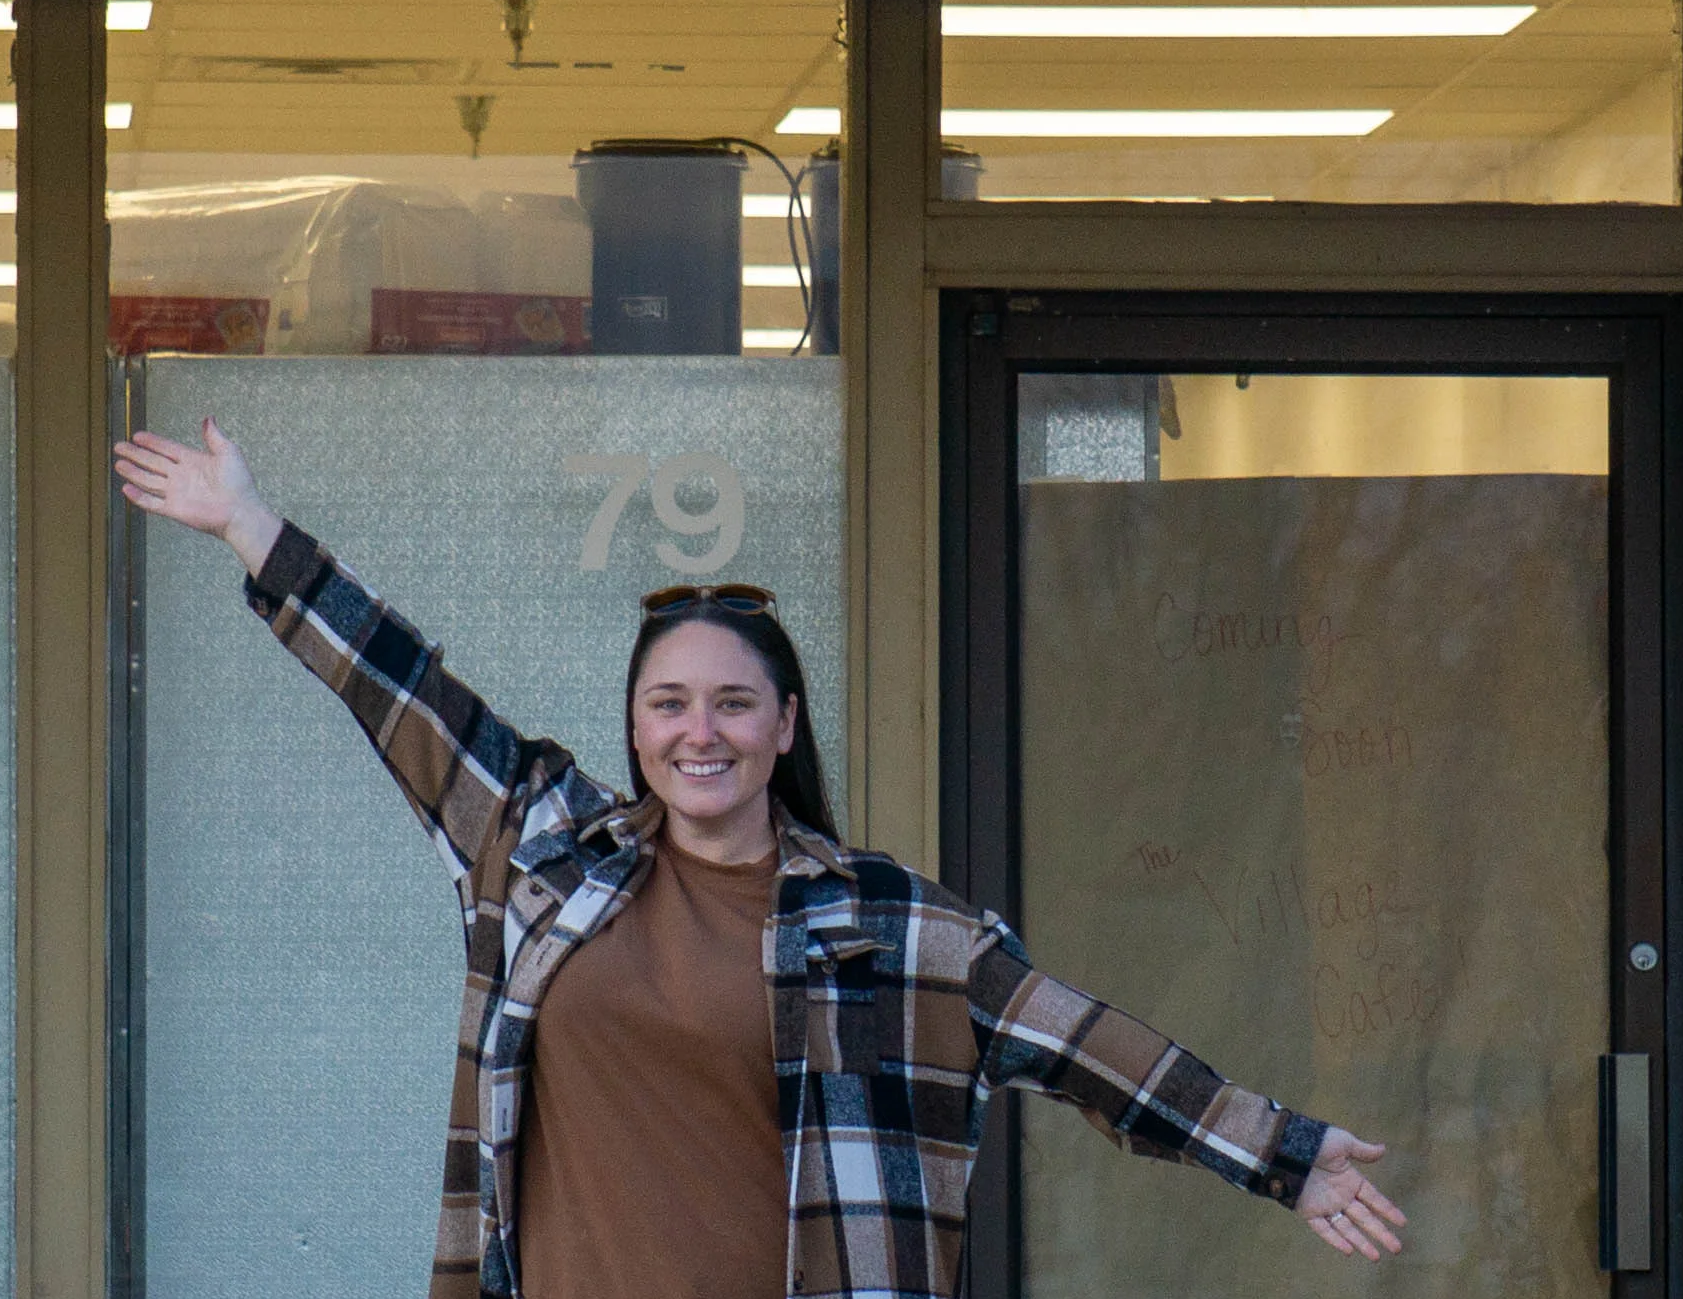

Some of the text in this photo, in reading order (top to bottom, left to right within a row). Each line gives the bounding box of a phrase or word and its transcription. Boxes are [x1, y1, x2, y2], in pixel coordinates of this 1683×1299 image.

[562, 450, 747, 576] 79
[1154, 590, 1366, 696] Coming
[1293, 695, 1417, 779] Soon
[1135, 839, 1184, 876] The
[1192, 863, 1416, 963] Village
